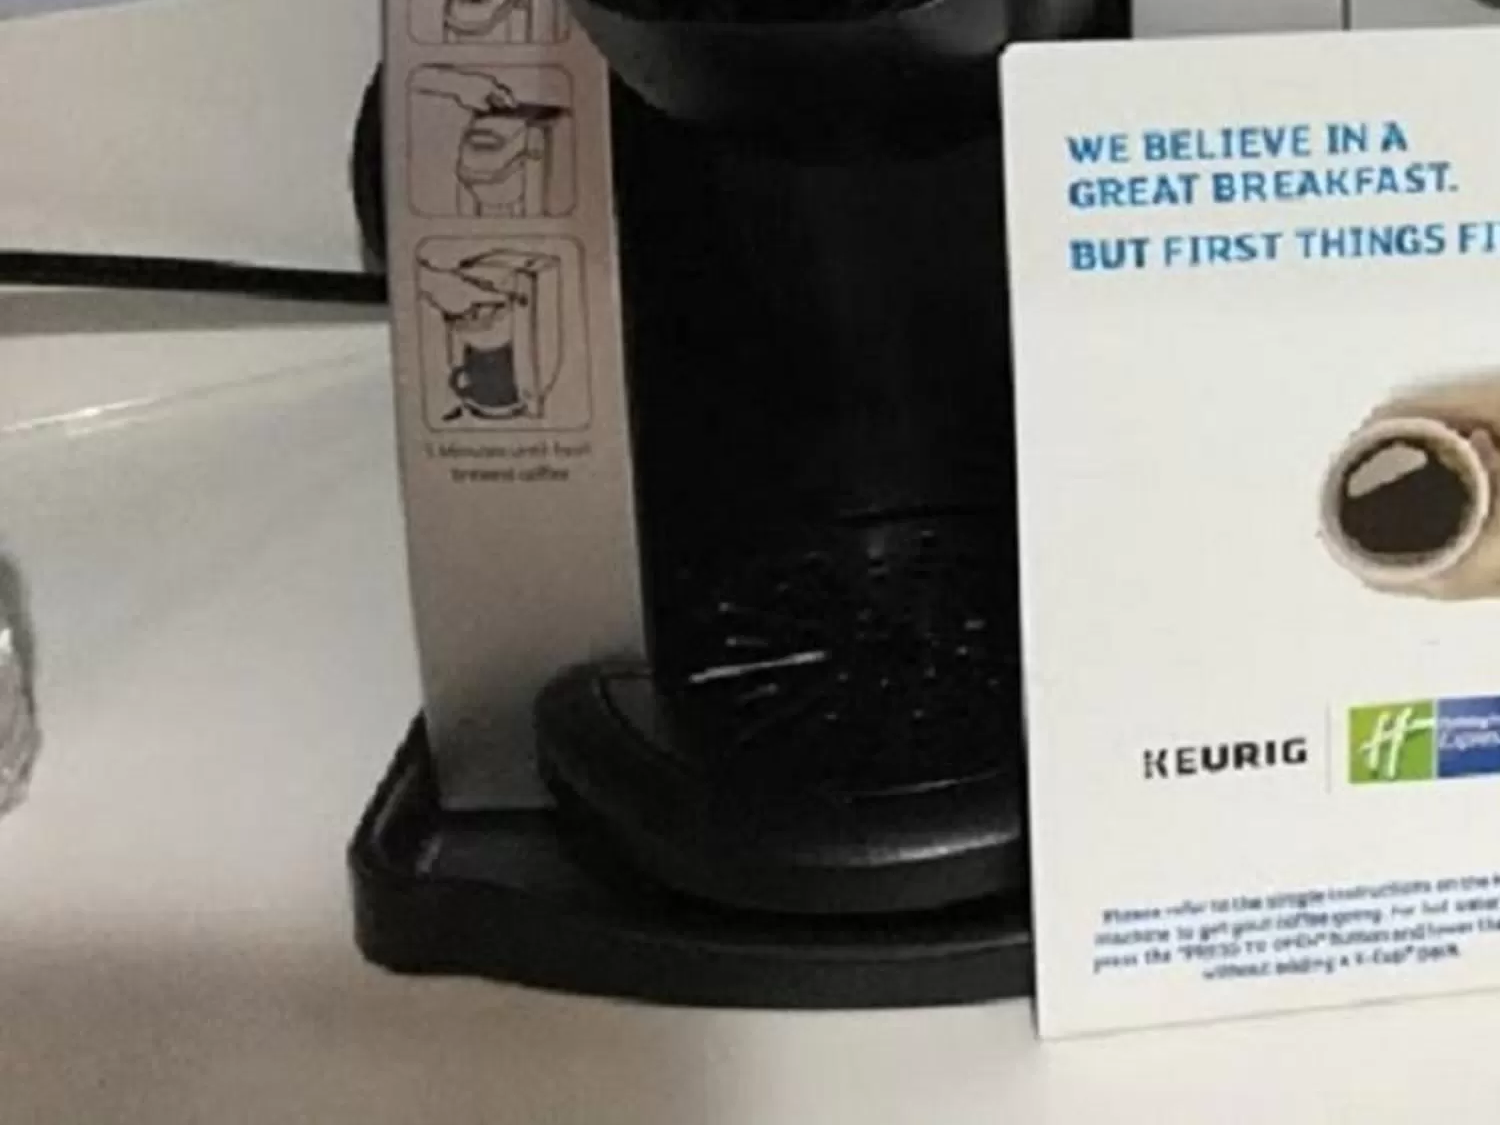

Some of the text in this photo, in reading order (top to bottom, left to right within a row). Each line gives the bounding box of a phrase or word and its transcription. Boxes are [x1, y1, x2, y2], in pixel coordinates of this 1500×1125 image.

[1067, 121, 1408, 164] WE BELIEVE IN A
[1067, 162, 1459, 209] GREAT BREAKFAST.
[1069, 237, 1150, 271] BUT
[1164, 232, 1283, 267] FIRST
[1297, 224, 1446, 259] THINGS
[1143, 737, 1308, 779] KEURIG
